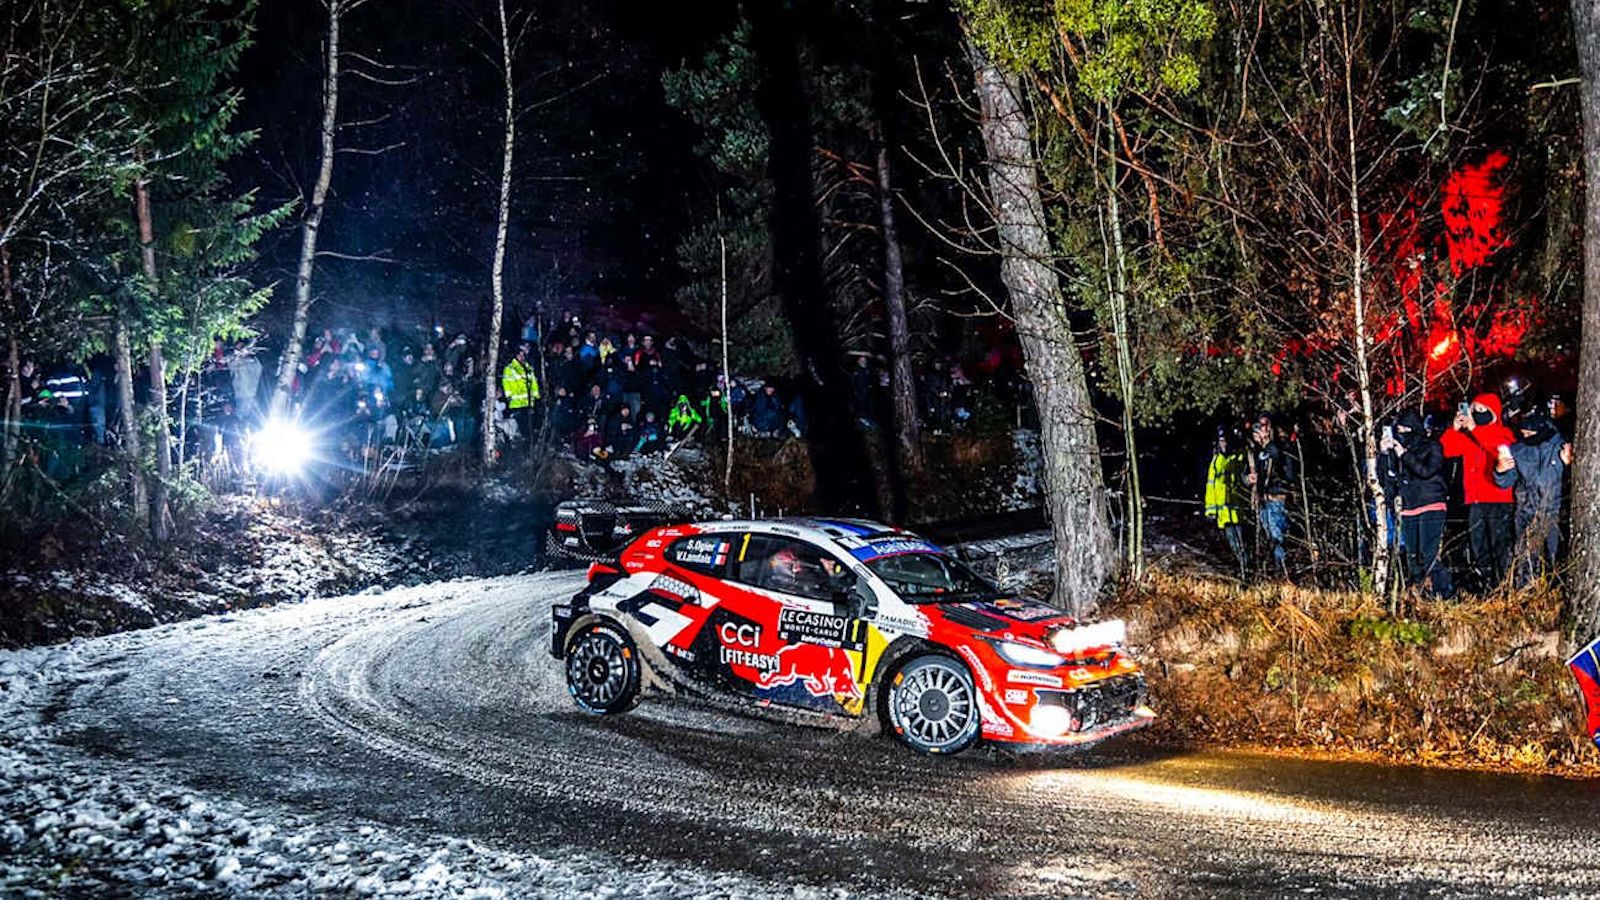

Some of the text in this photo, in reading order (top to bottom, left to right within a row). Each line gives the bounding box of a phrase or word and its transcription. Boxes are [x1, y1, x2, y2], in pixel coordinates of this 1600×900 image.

[686, 539, 715, 553] S.Ogier
[738, 533, 751, 562] 1
[676, 551, 712, 565] V.Landais
[782, 610, 844, 630] LE CASINO
[721, 621, 761, 648] CCi
[784, 623, 839, 638] MONTE-CARLO
[851, 618, 860, 643] 1
